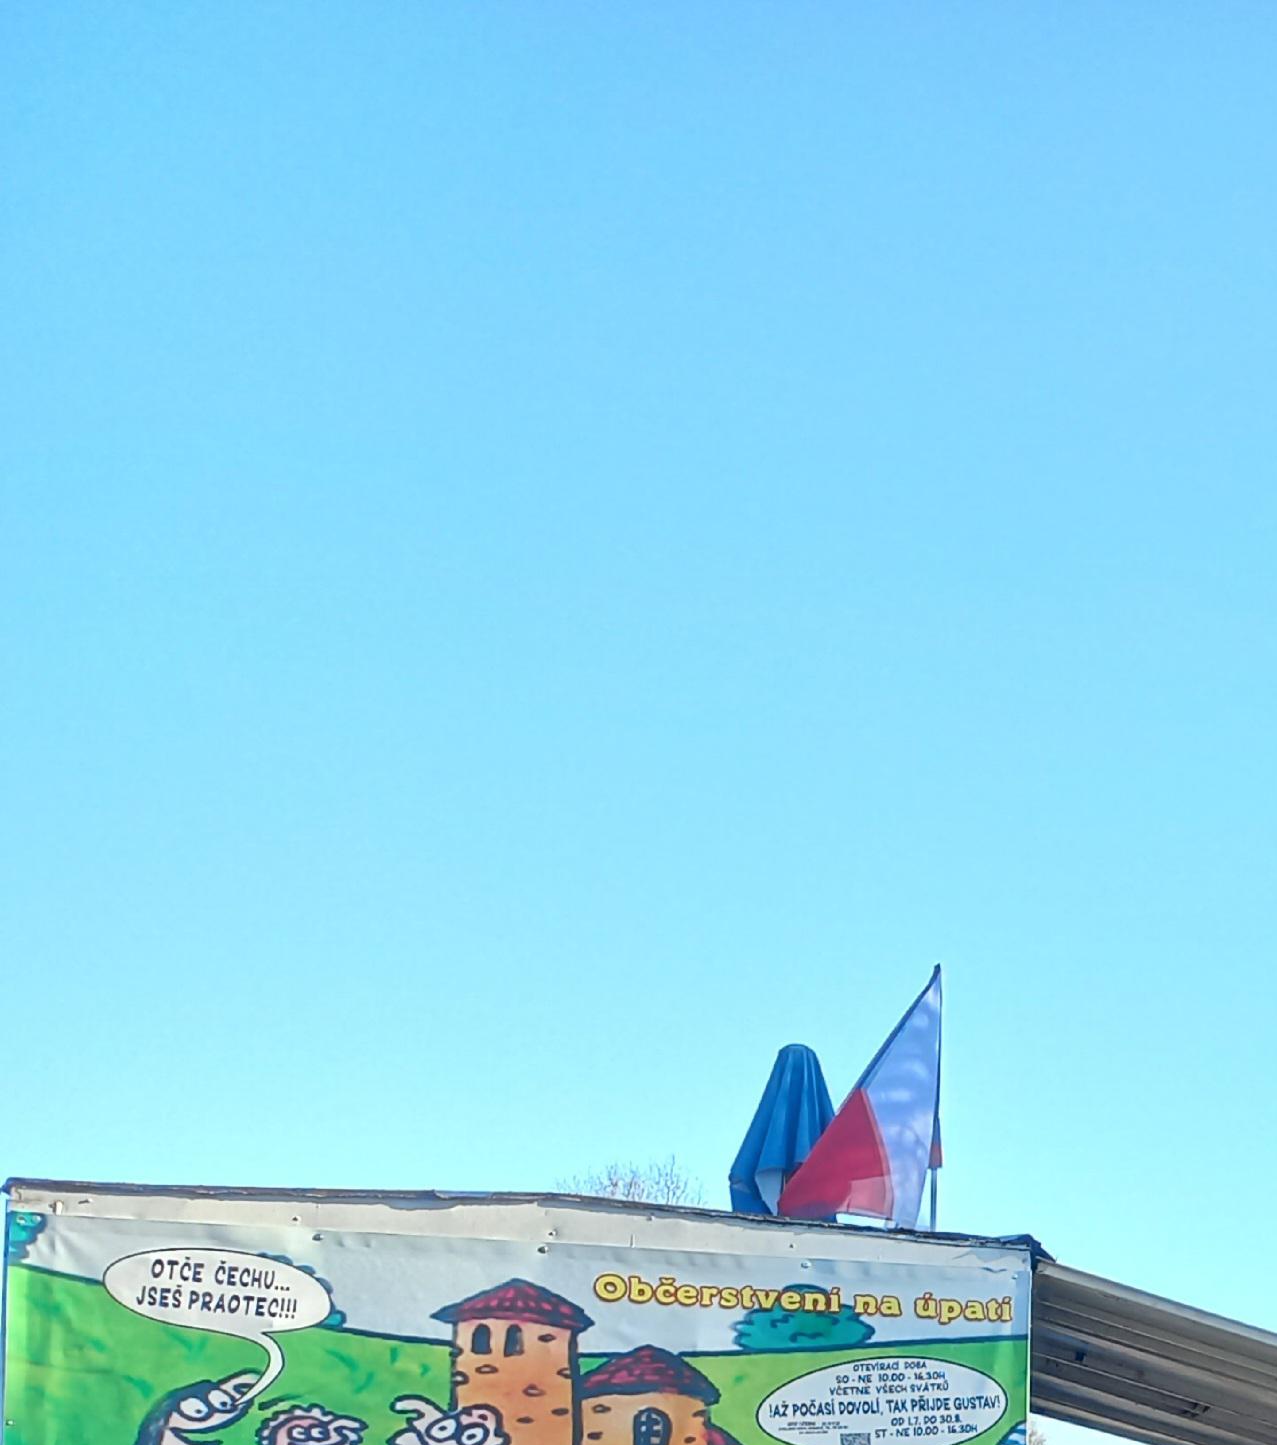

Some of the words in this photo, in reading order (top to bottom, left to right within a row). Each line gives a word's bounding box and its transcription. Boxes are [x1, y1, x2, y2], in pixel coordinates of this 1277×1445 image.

[151, 1257, 204, 1283] OTČE
[214, 1260, 290, 1291] ČECHU...
[136, 1285, 182, 1308] JSEŠ
[188, 1290, 297, 1319] PRAOTEC!!!
[594, 1273, 841, 1315] Občerstvení
[853, 1293, 902, 1316] na
[914, 1292, 1013, 1324] úpatí
[904, 1361, 927, 1370] DOBA
[836, 1374, 850, 1384] SO
[858, 1374, 872, 1383] NE
[792, 1399, 835, 1417] POČASÍ
[886, 1399, 908, 1413] TAK
[910, 1396, 950, 1412] PŘIJDE
[953, 1395, 1000, 1411] GUSTAV!
[891, 1417, 905, 1427] OD
[924, 1416, 937, 1425] DO
[896, 1428, 910, 1437] NE
